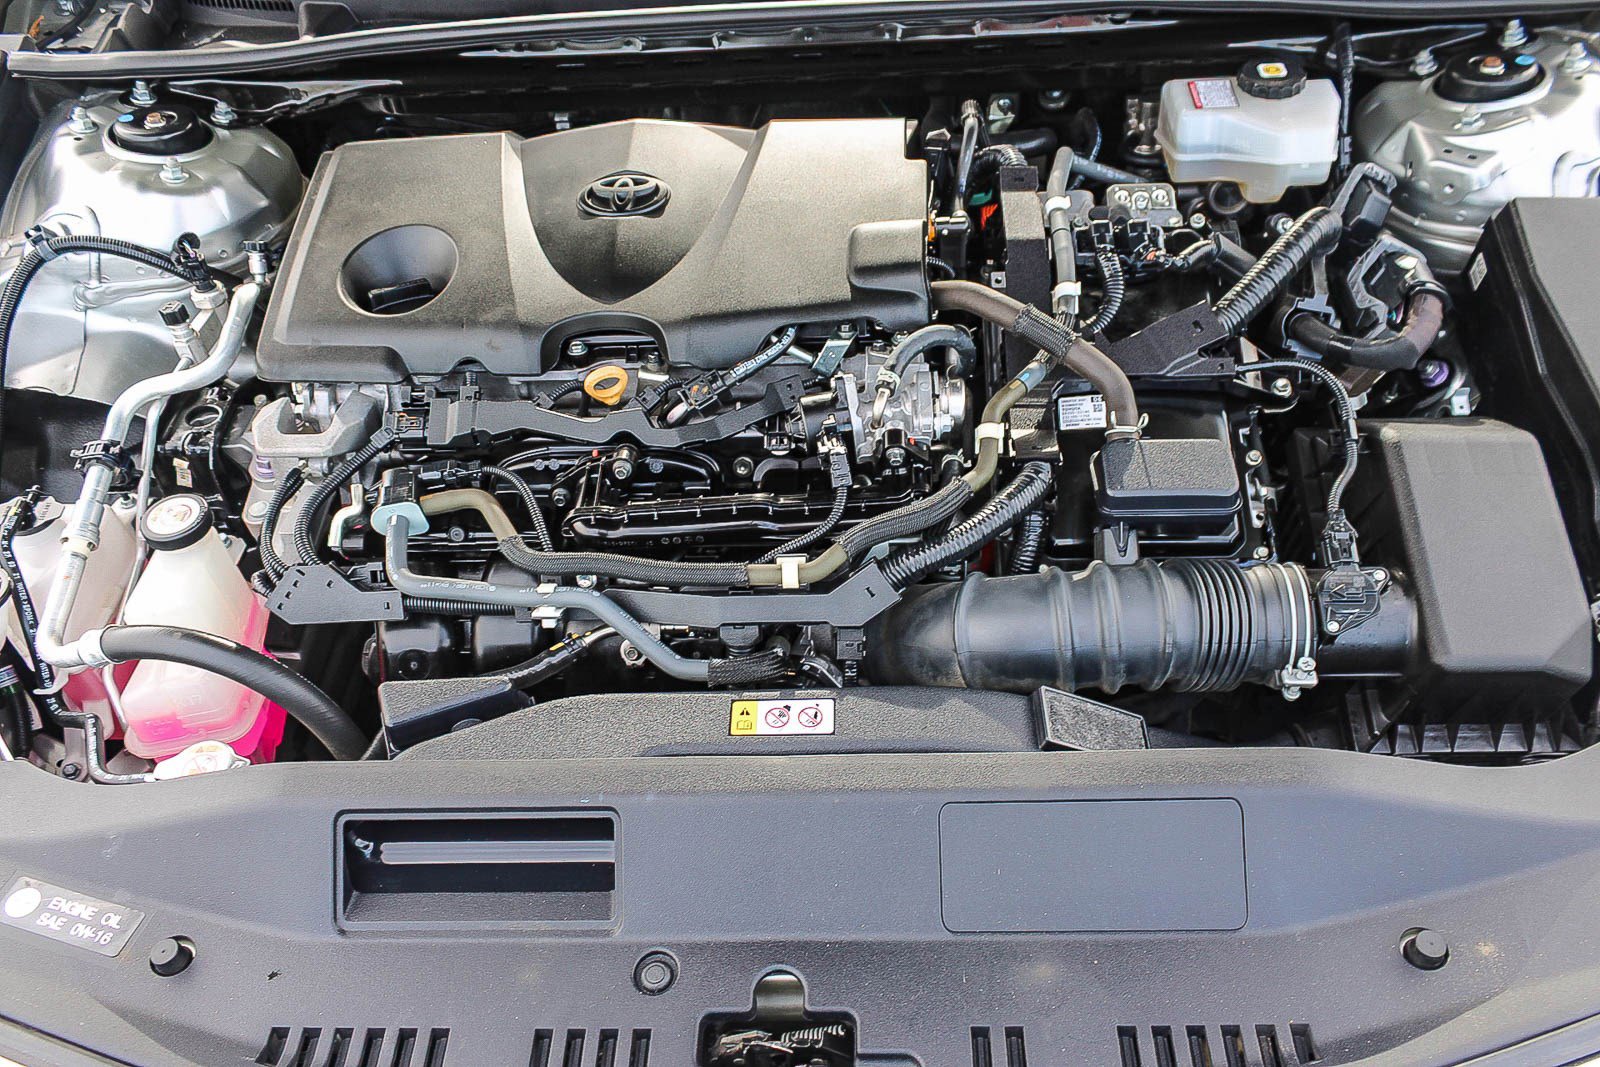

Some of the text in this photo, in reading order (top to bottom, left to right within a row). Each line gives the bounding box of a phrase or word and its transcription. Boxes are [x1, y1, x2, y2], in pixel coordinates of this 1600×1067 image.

[36, 912, 114, 945] SAE 0W-16
[47, 896, 122, 929] ENGINE OIL
